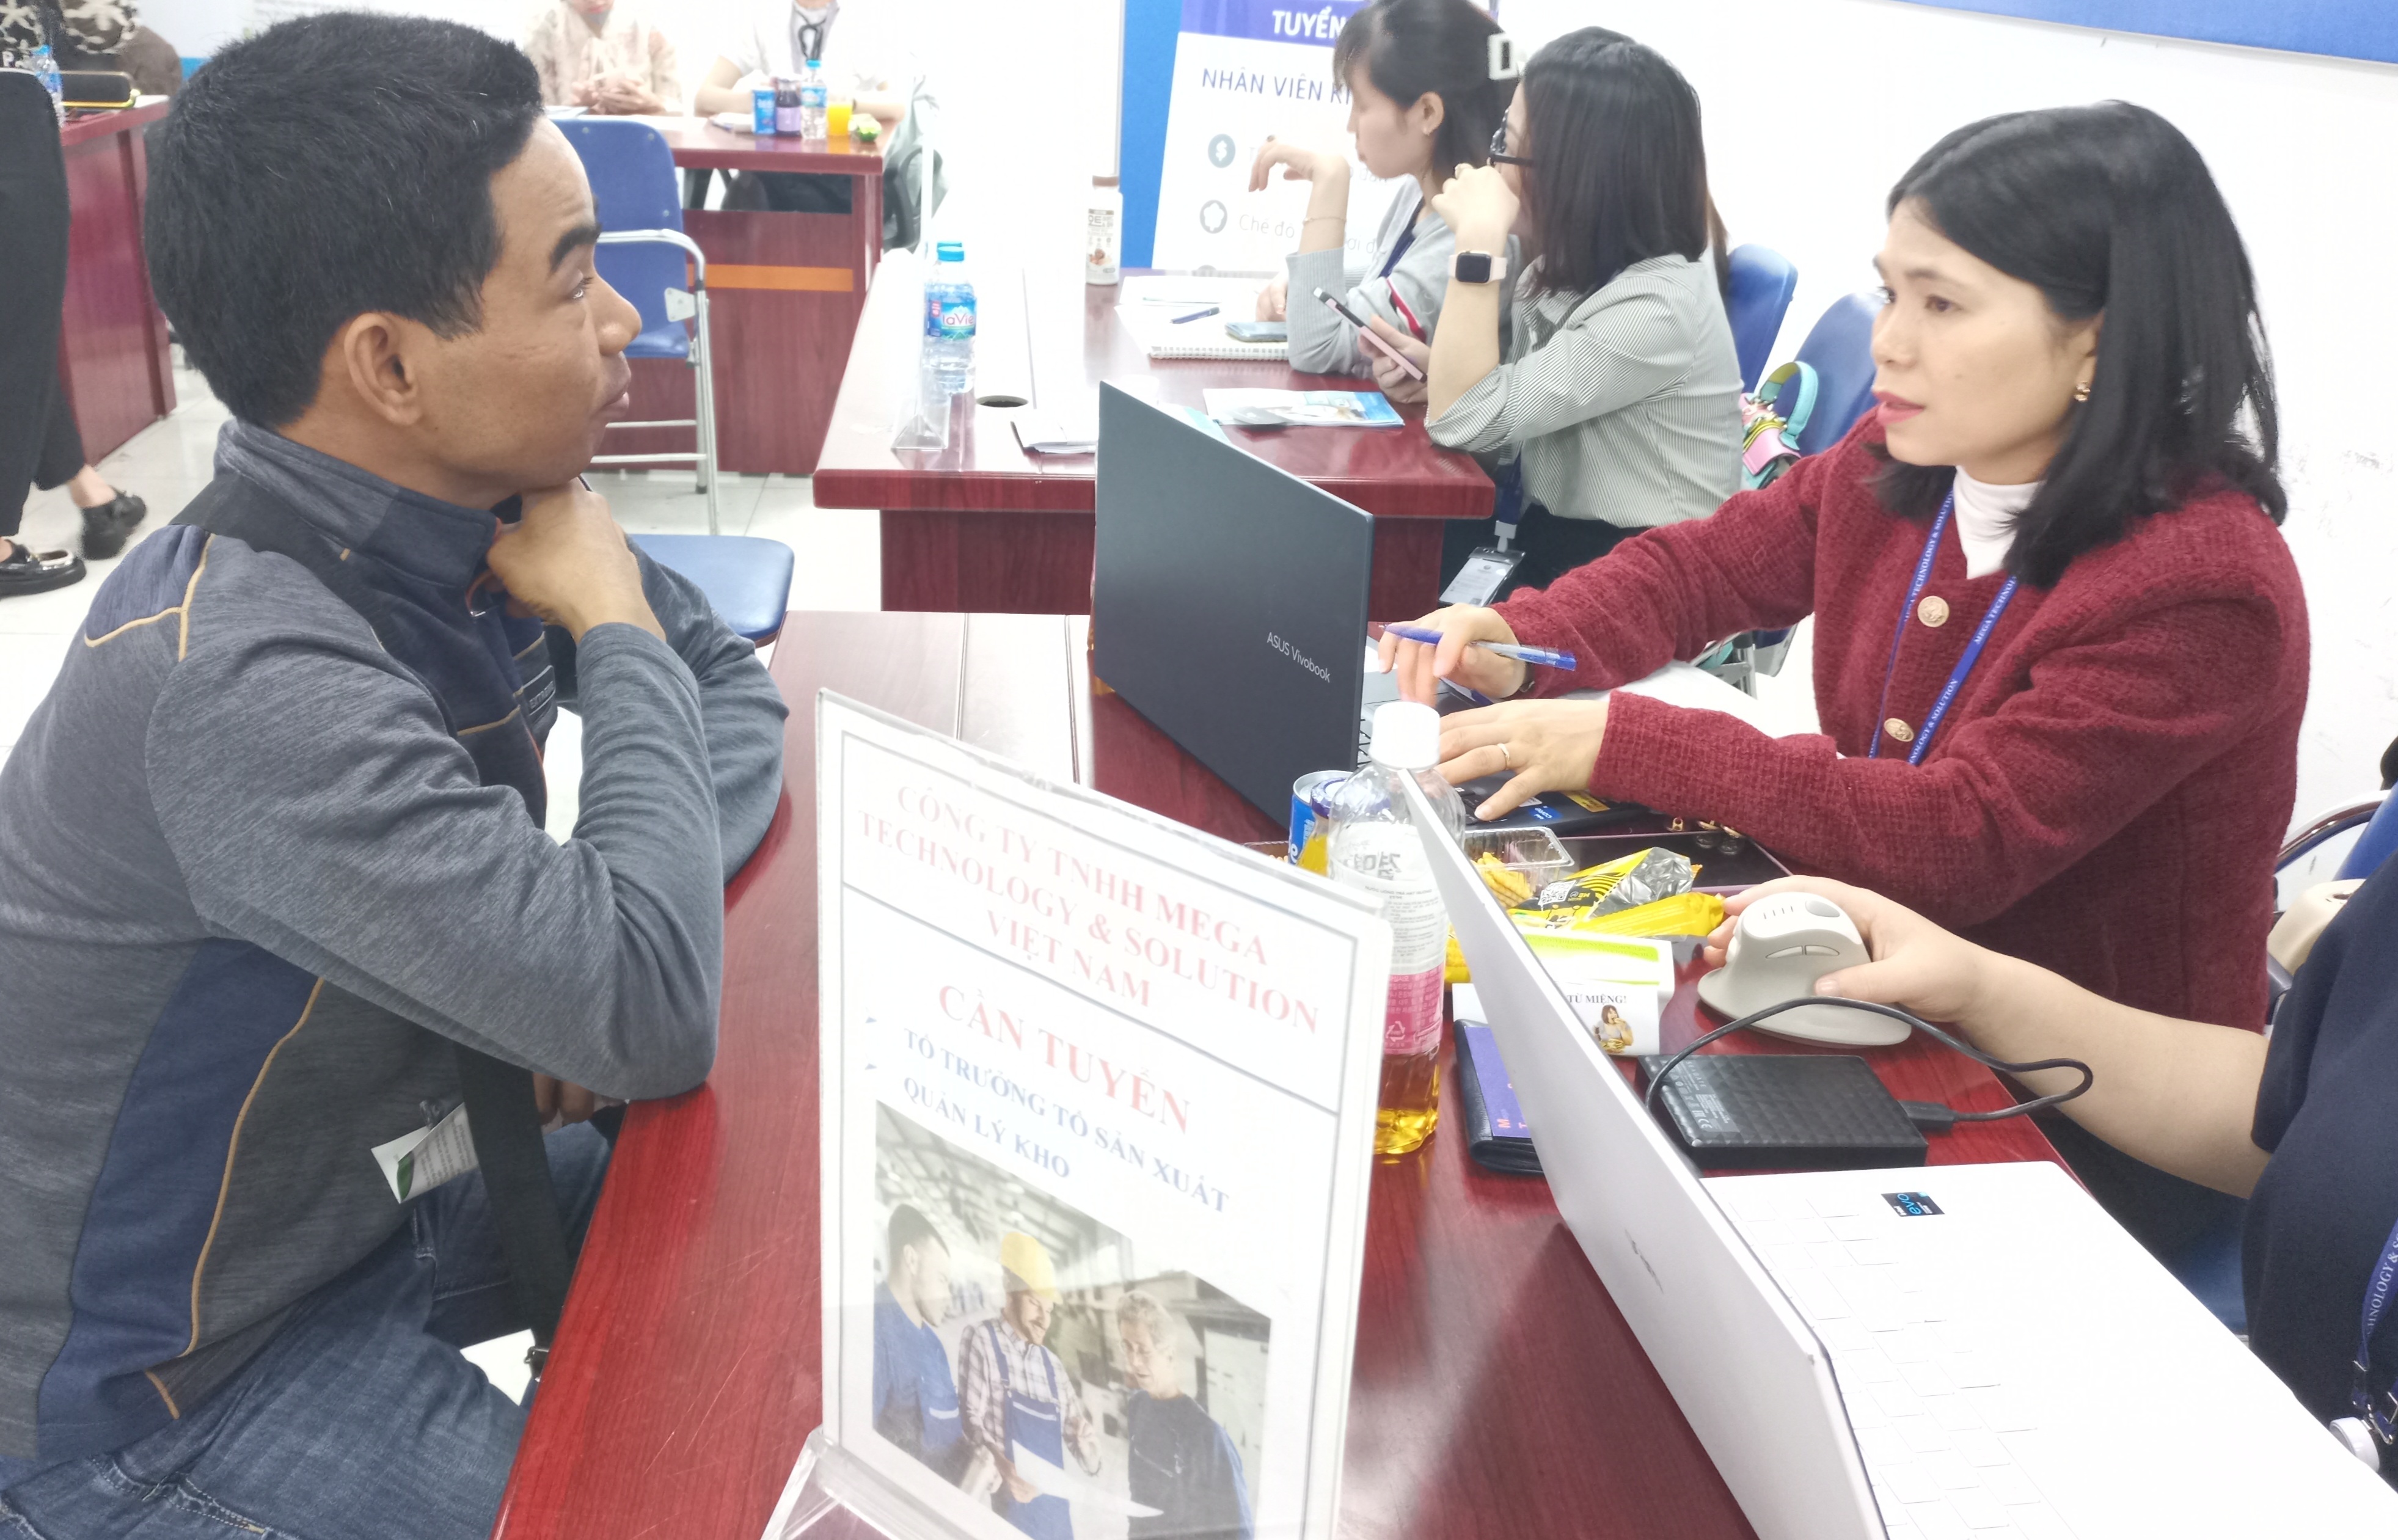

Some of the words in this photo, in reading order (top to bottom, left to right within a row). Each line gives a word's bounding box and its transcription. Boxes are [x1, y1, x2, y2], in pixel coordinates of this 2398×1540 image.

[1202, 67, 1263, 94] NHÂN
[1274, 68, 1324, 101] VIÊN
[943, 313, 974, 325] laVie
[1912, 539, 1936, 598] TECHNOLOGY
[1267, 632, 1290, 656] ASUS
[1291, 646, 1331, 683] Vivobook
[1973, 619, 1993, 645] MEGA
[1931, 678, 1959, 721] SOLUTION
[897, 786, 986, 843] CÔNG
[996, 825, 1037, 864] TY
[1047, 846, 1144, 914] TNHH
[1155, 892, 1268, 966] MEGA
[858, 809, 1078, 927] TECHNOLOGY
[1088, 913, 1112, 944] &
[1124, 926, 1319, 1035] SOLUTION
[987, 909, 1063, 965] VIỆT
[1072, 947, 1150, 1008] NAM
[1585, 994, 1628, 1005] MIỆNG!
[938, 984, 1025, 1051] CẦN
[1038, 1028, 1191, 1135] TUYỂN
[904, 1077, 967, 1126] QUẢN
[974, 1114, 1007, 1145] LÝ
[1014, 1133, 1070, 1179] KHO
[940, 1048, 1046, 1117] TRƯỞNG
[1094, 1126, 1146, 1169] SẢN
[1152, 1157, 1230, 1213] XUẤT
[1897, 1193, 1922, 1215] evo
[2387, 1252, 2398, 1263] &
